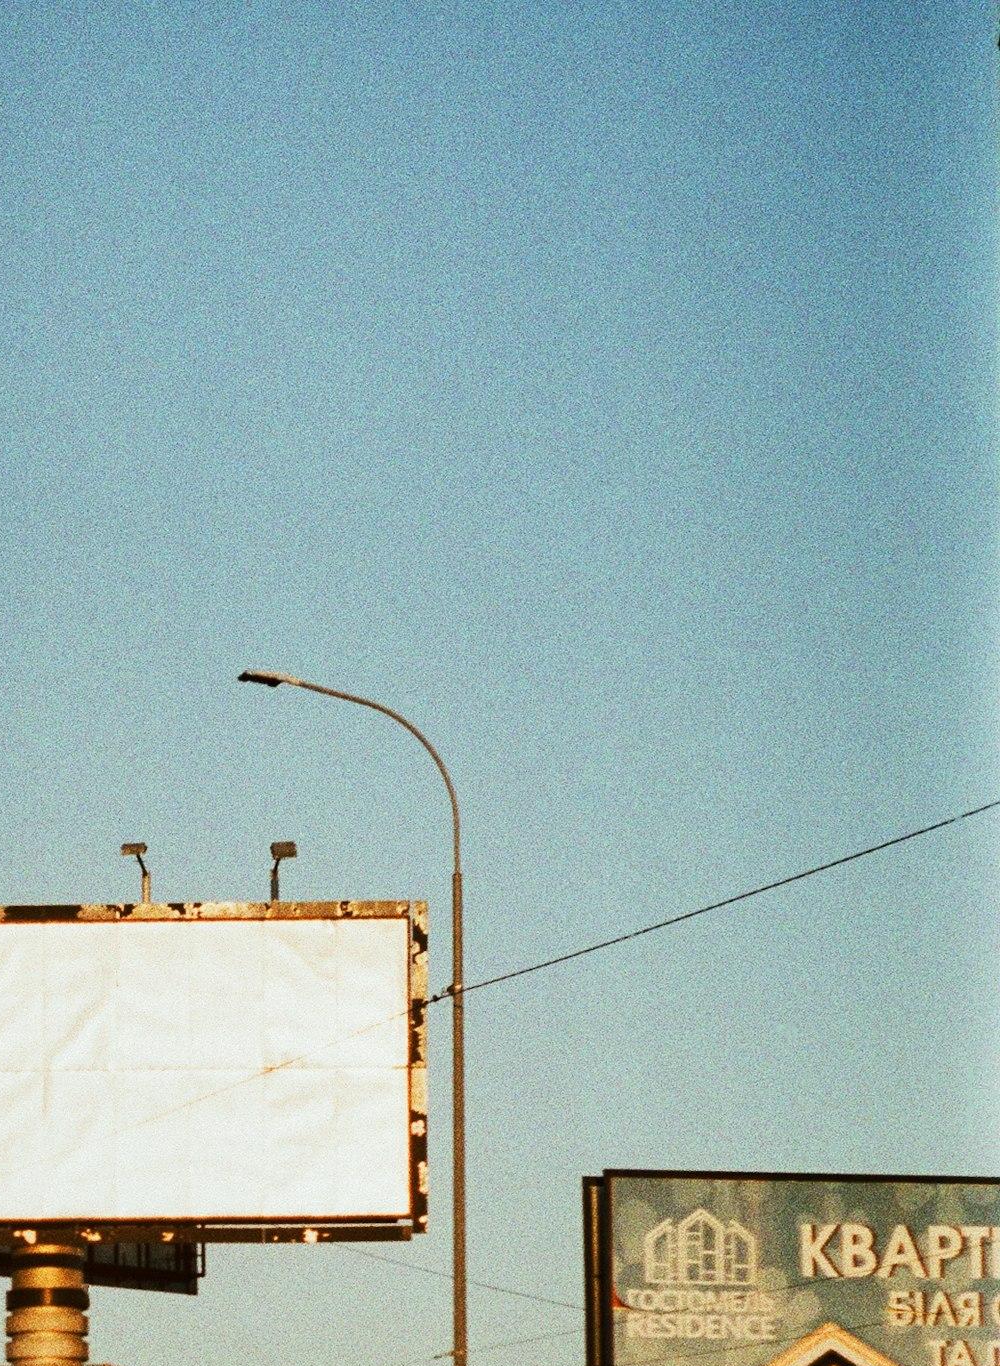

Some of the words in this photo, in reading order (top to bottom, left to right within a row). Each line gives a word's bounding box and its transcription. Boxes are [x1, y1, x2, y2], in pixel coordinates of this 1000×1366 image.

[800, 1223, 1000, 1279] КВАРТ
[626, 1314, 777, 1340] RESIDENCE
[887, 1291, 982, 1327] БІЛЯ
